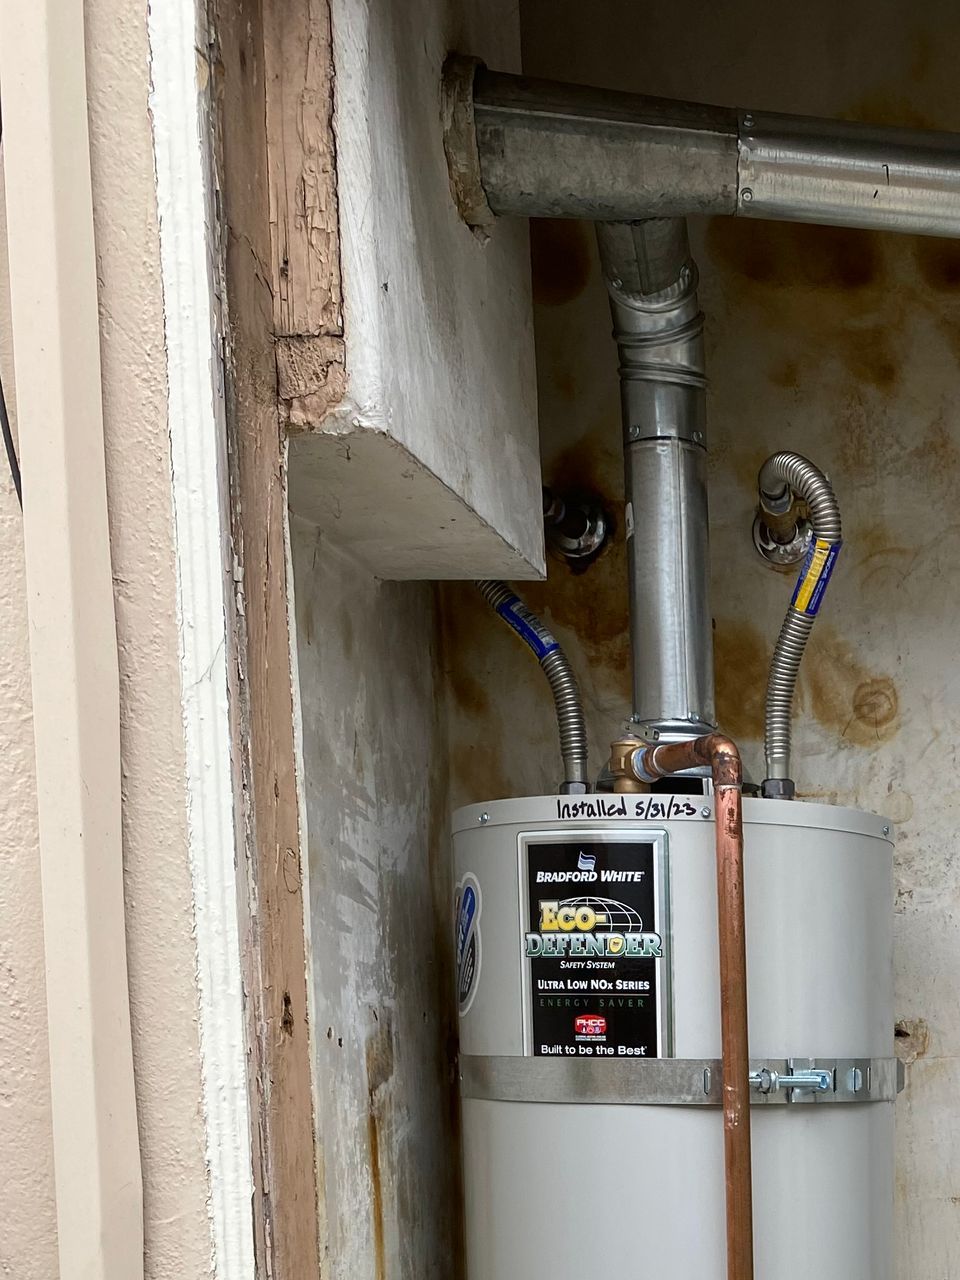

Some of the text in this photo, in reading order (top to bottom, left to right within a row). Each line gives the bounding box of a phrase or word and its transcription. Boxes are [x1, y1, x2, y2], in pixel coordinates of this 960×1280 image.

[557, 795, 697, 820] Installed 5/31/23
[536, 870, 642, 883] BRADFORD WHITE
[526, 932, 663, 957] DEFENDER
[560, 961, 616, 969] SAFETY SYSTEM
[538, 980, 564, 990] ULTRA
[567, 980, 588, 990] LOW
[616, 980, 650, 990] SERIES
[540, 999, 644, 1008] ENERGY SAVER
[577, 1019, 606, 1027] PHCC
[541, 1045, 646, 1055] Built to be the Best
